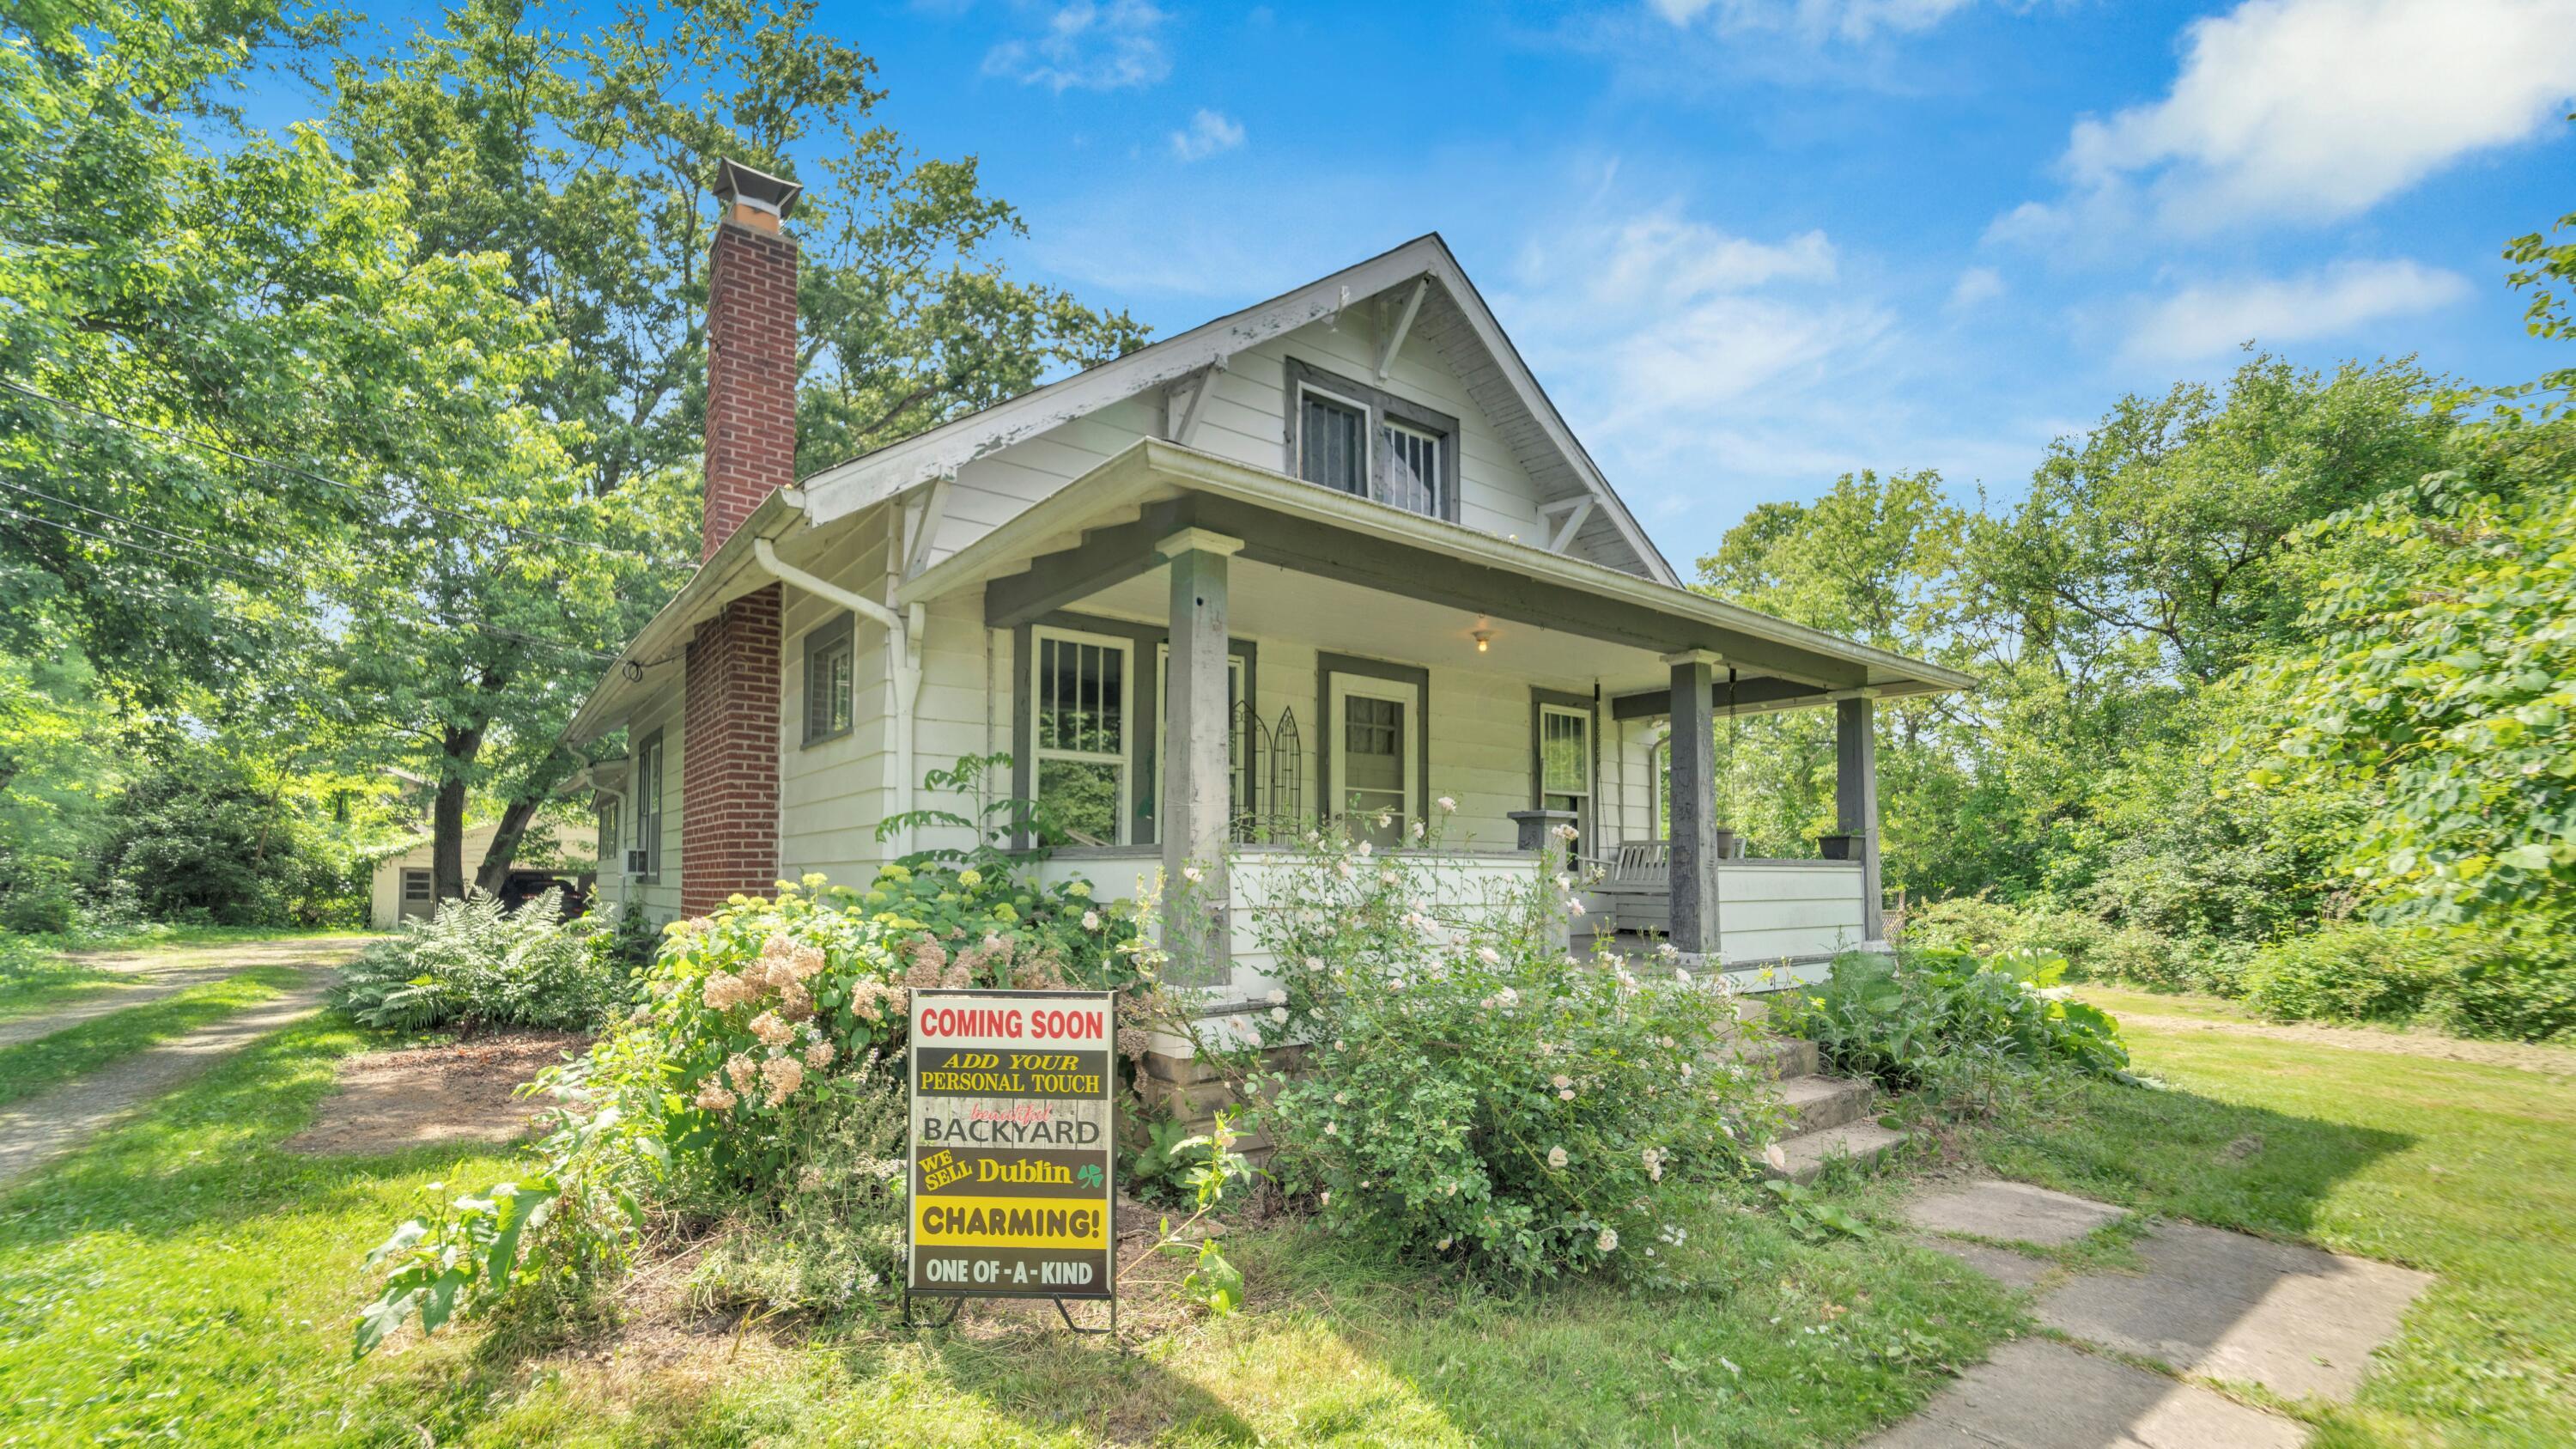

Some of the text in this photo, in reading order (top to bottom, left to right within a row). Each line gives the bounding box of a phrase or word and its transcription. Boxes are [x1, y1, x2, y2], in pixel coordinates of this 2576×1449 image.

[920, 1008, 1103, 1039] COMING SOON
[942, 1053, 1079, 1071] ADD YOUR
[920, 1072, 1100, 1093] PERSONAL TOUCH
[969, 1103, 1053, 1126] beautiful
[924, 1117, 1100, 1144] BACKYARD
[919, 1149, 953, 1173] WE
[976, 1159, 1073, 1184] Dublin
[925, 1160, 973, 1192] SELL
[922, 1206, 1100, 1239] CHARMING!
[926, 1258, 969, 1282] ONE
